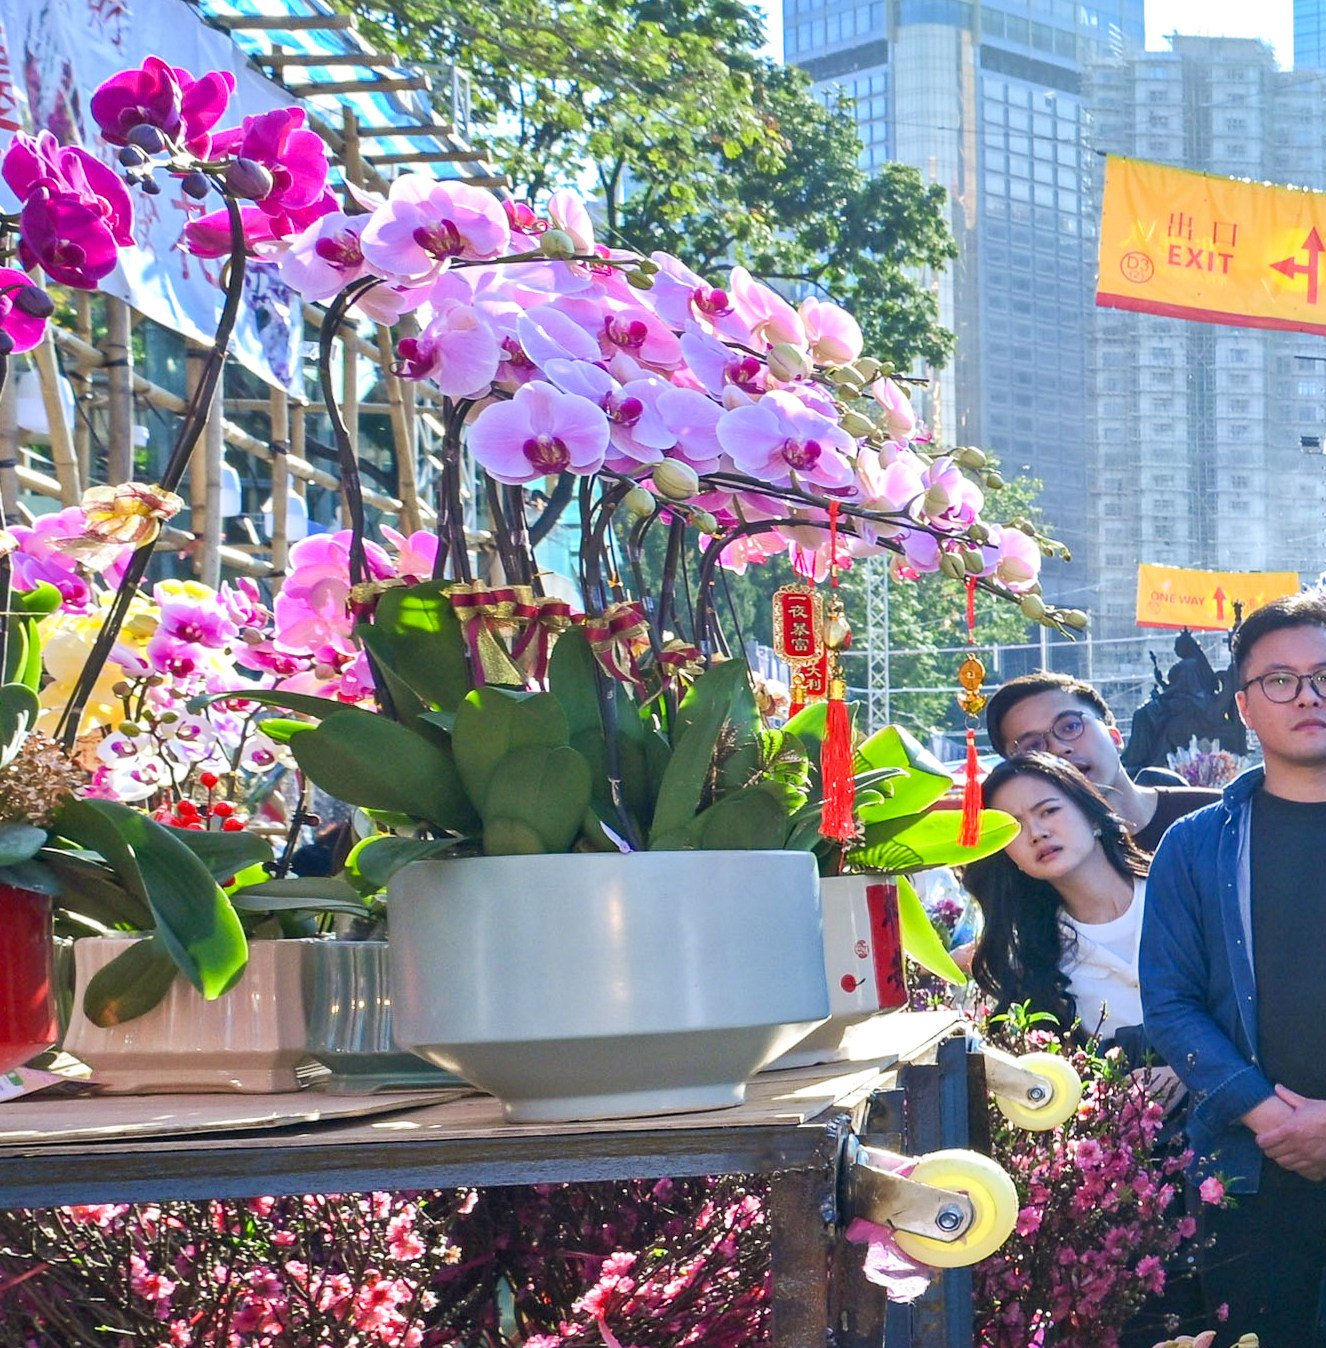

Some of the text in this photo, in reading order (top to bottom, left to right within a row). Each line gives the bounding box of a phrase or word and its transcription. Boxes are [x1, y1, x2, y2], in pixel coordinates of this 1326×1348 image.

[1167, 211, 1238, 248] 出口
[1126, 256, 1150, 272] D3
[1167, 243, 1235, 275] EXIT
[1150, 591, 1206, 607] ONE WAY
[788, 596, 810, 652] 一夜暴富
